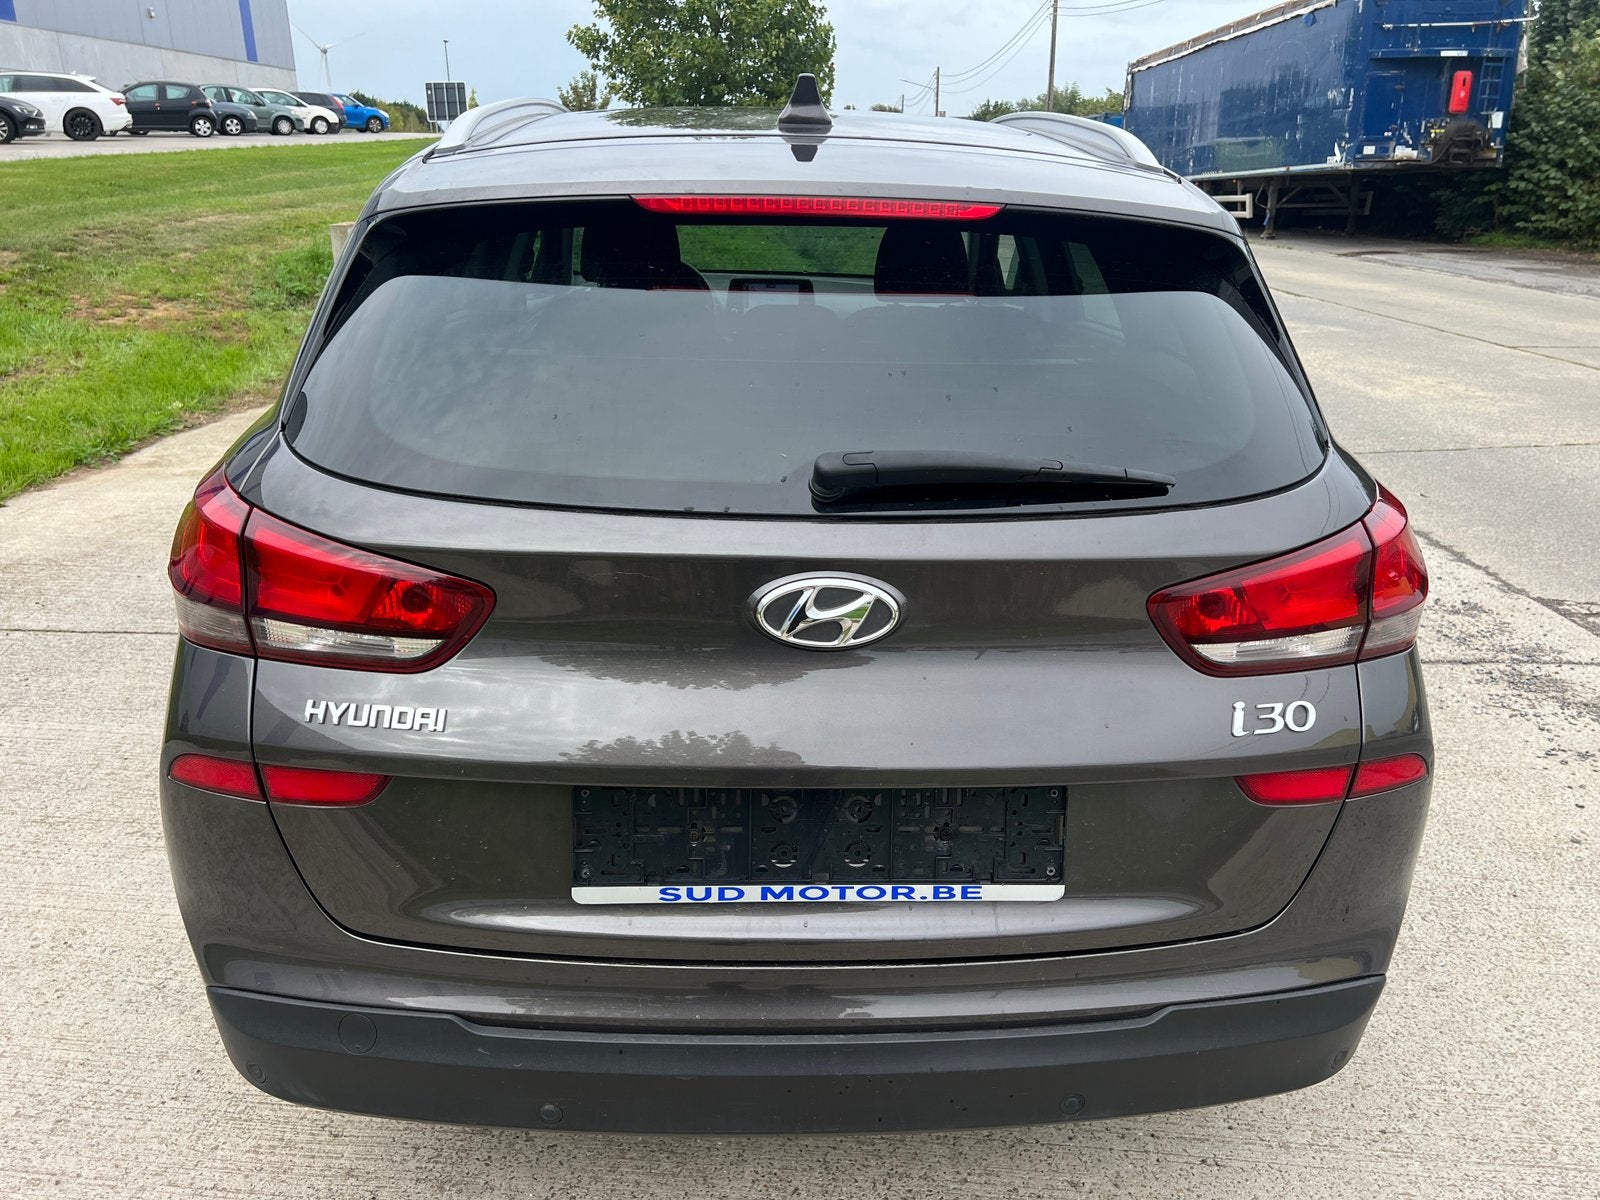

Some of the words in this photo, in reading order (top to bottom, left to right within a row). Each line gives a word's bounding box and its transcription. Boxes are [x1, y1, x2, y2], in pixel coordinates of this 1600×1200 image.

[304, 699, 448, 732] HYUNDAI
[1231, 700, 1317, 737] i30
[658, 886, 745, 902] SUD
[760, 885, 983, 901] MOTOR.BE
